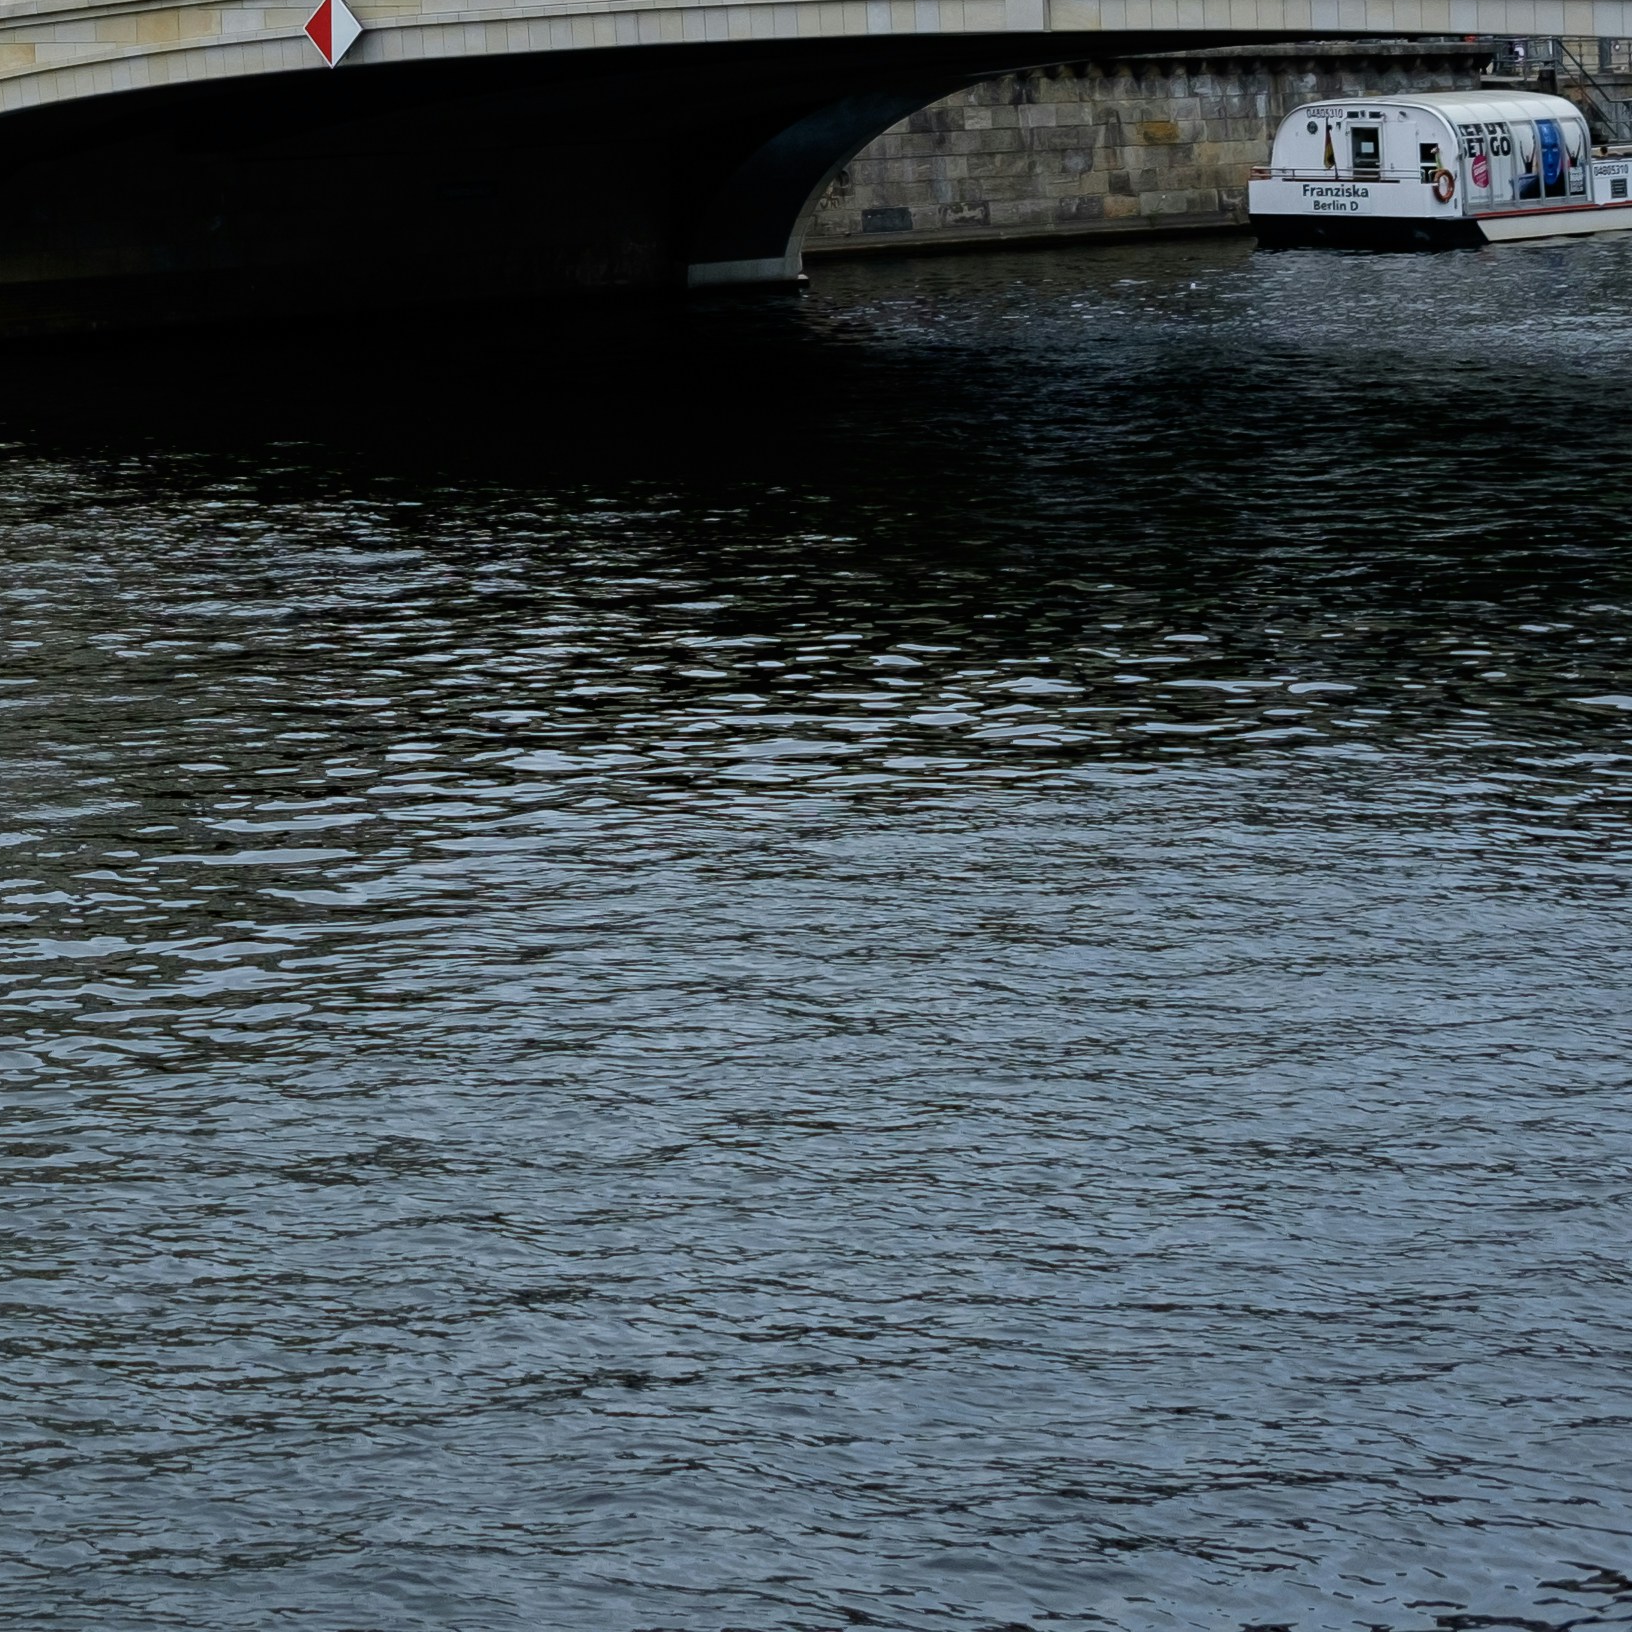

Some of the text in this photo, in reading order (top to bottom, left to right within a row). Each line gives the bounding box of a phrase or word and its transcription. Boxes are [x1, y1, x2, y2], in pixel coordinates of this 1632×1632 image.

[1490, 136, 1512, 157] GO
[1302, 184, 1369, 197] Franziska
[1313, 200, 1359, 211] Berlin D
